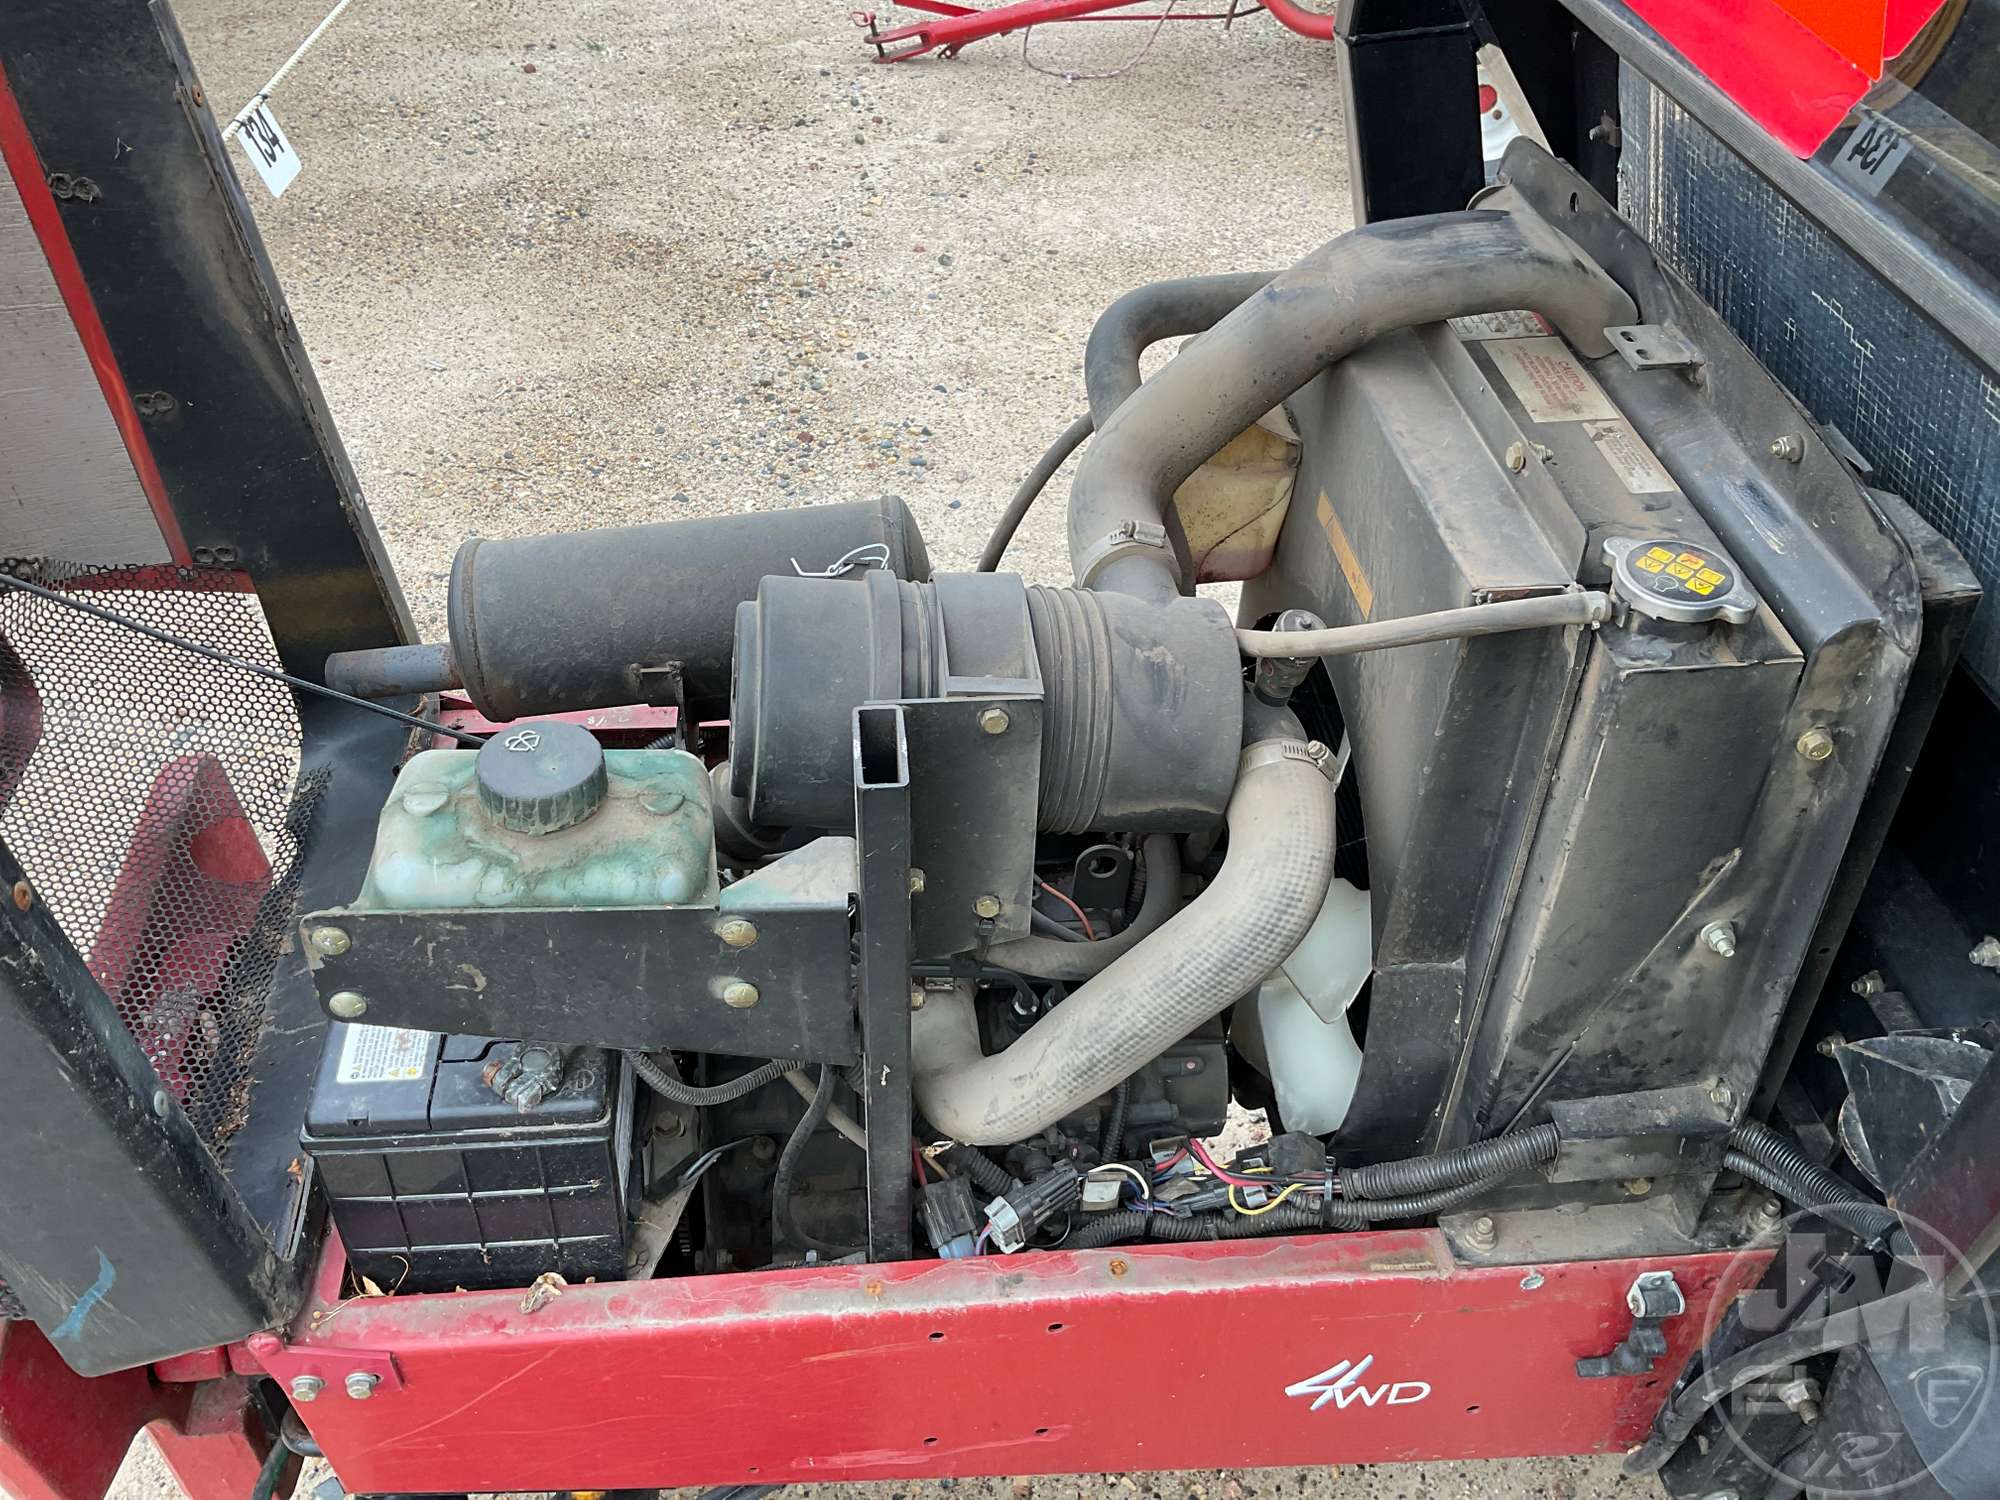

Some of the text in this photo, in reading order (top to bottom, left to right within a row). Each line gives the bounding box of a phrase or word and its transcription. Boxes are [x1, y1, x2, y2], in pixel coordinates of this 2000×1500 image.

[242, 107, 285, 168] 134
[1558, 360, 1588, 392] CAUTION
[1285, 1353, 1431, 1411] 4WD
